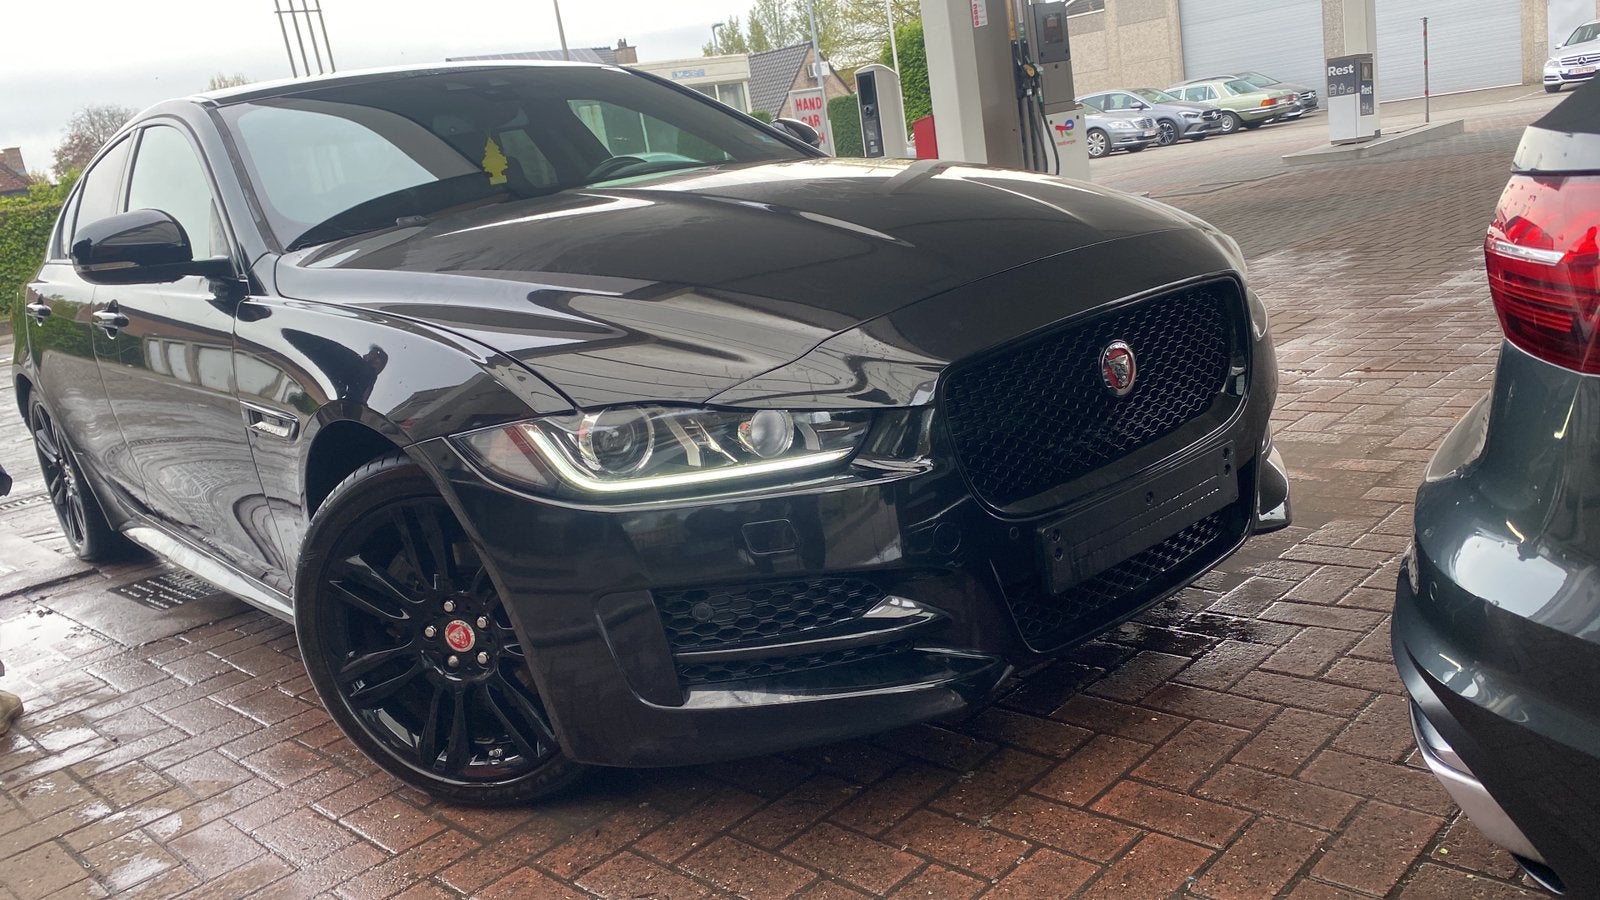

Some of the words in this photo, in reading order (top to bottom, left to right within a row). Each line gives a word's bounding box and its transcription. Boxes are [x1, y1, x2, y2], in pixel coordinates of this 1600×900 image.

[1328, 64, 1354, 77] Rest
[1361, 84, 1372, 95] Rest
[795, 97, 822, 111] HAND
